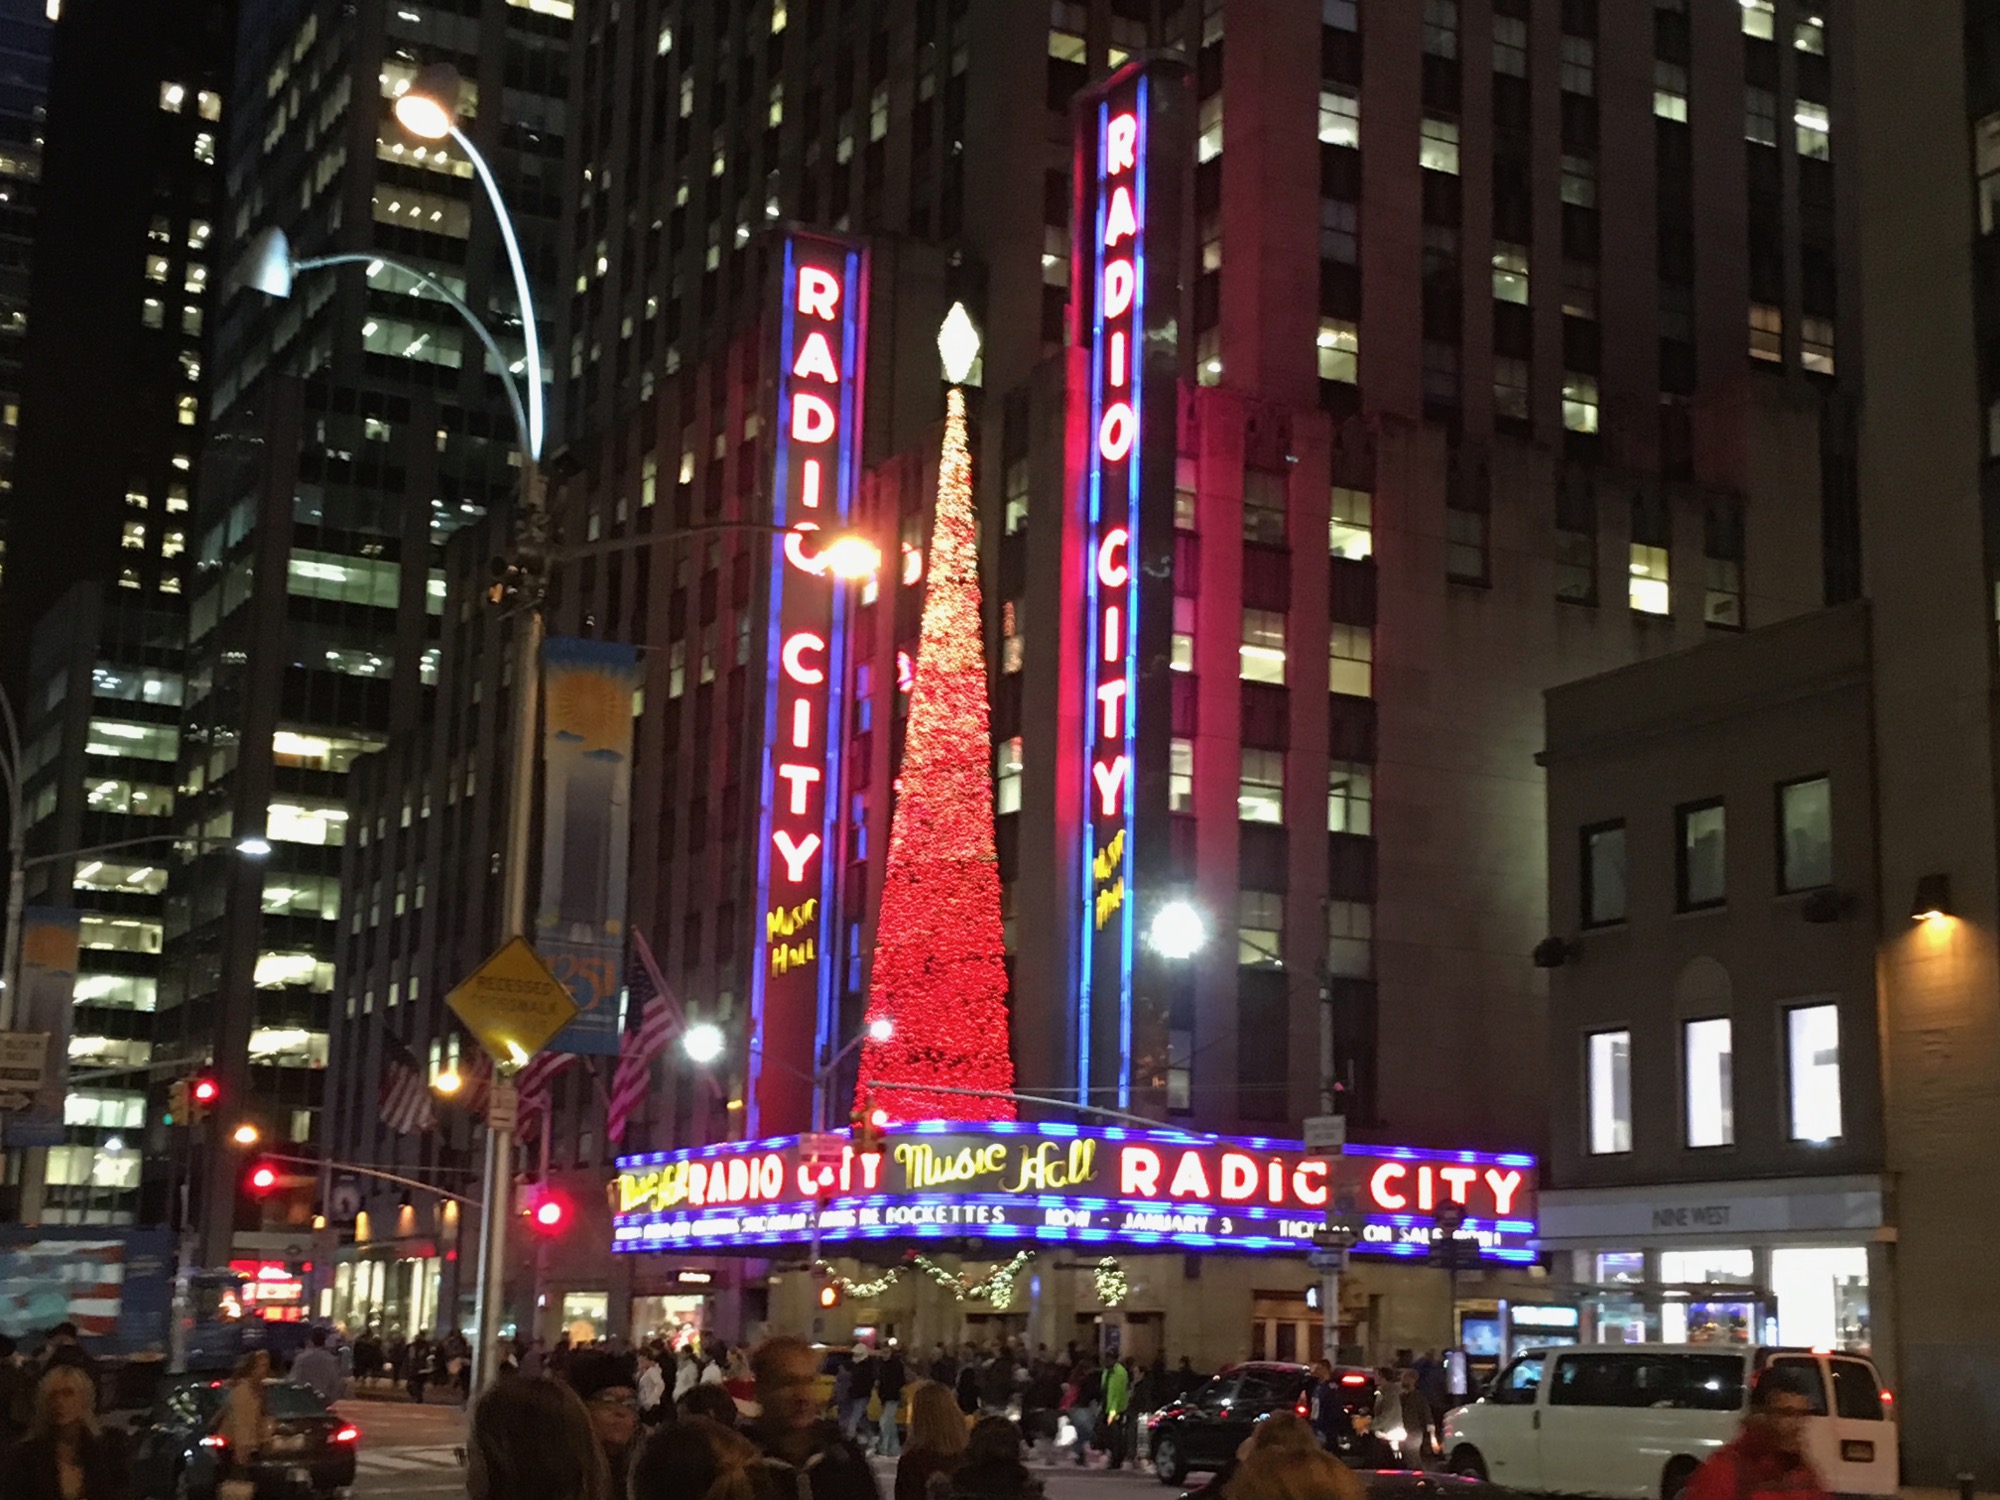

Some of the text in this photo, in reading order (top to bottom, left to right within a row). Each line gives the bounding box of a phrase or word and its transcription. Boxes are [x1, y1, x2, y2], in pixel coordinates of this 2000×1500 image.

[1093, 112, 1138, 817] RADIO CITY
[772, 632, 825, 883] CITY
[689, 1153, 784, 1206] RADIO
[894, 1143, 1007, 1189] Music
[998, 1138, 1098, 1192] Hall
[1370, 1162, 1522, 1215] CITY
[1121, 1212, 1208, 1233] JANUARY
[1220, 1216, 1233, 1234] 3
[1362, 1224, 1392, 1242] ON
[1690, 1206, 1731, 1225] WEST
